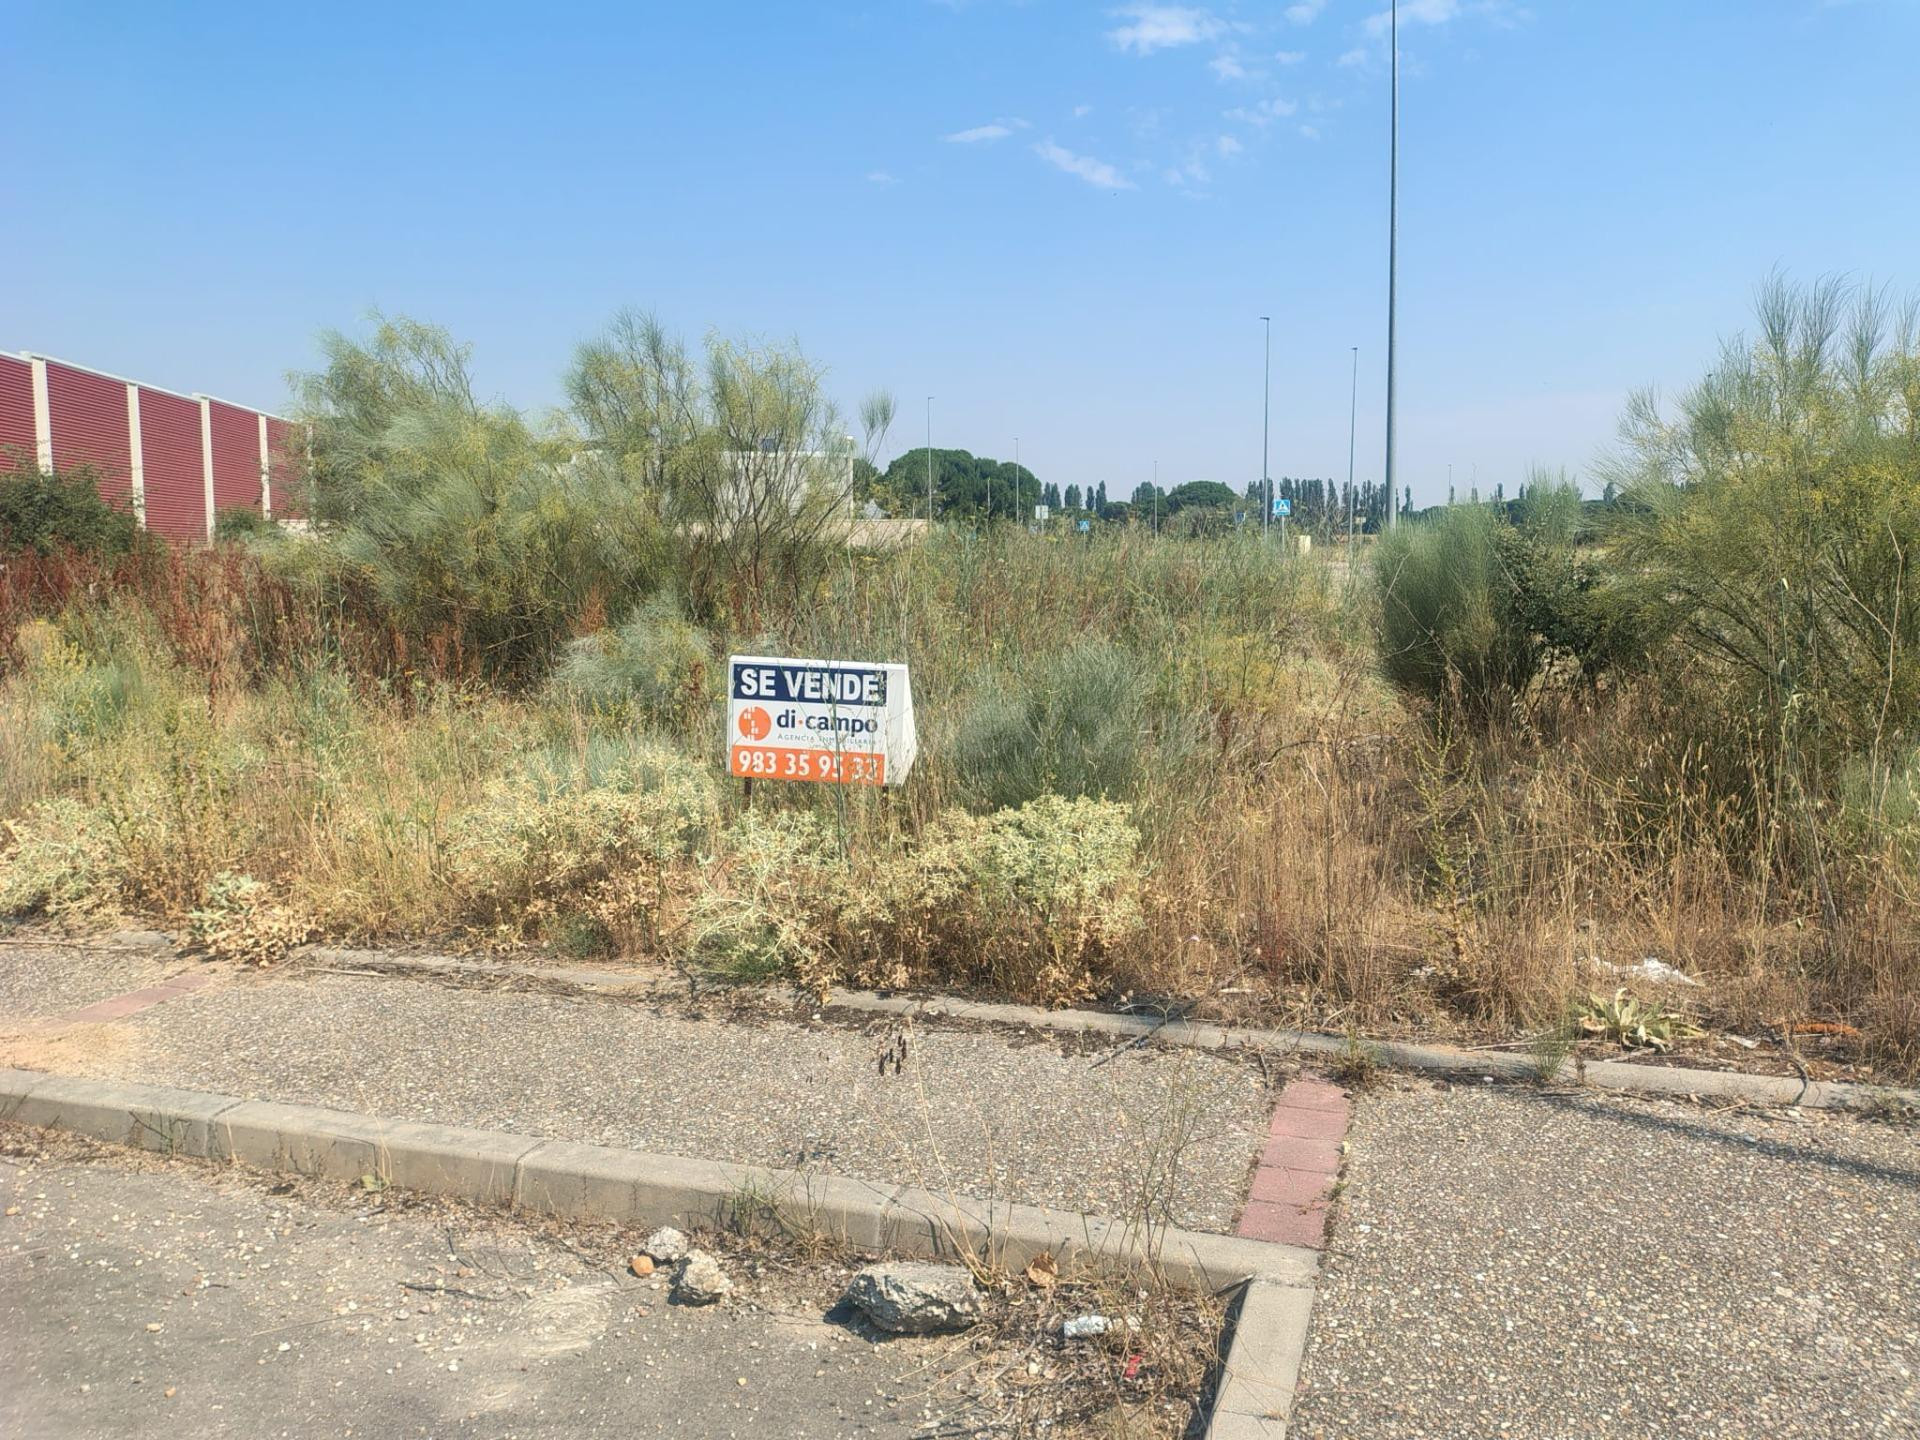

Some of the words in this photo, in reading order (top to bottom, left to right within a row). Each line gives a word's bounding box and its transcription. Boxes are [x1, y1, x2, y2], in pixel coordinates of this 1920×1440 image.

[741, 668, 776, 697] SE
[785, 670, 880, 702] VENDE
[777, 733, 816, 743] AGENCIA
[738, 750, 777, 774] 983
[784, 753, 810, 777] 35
[818, 755, 844, 778] 95
